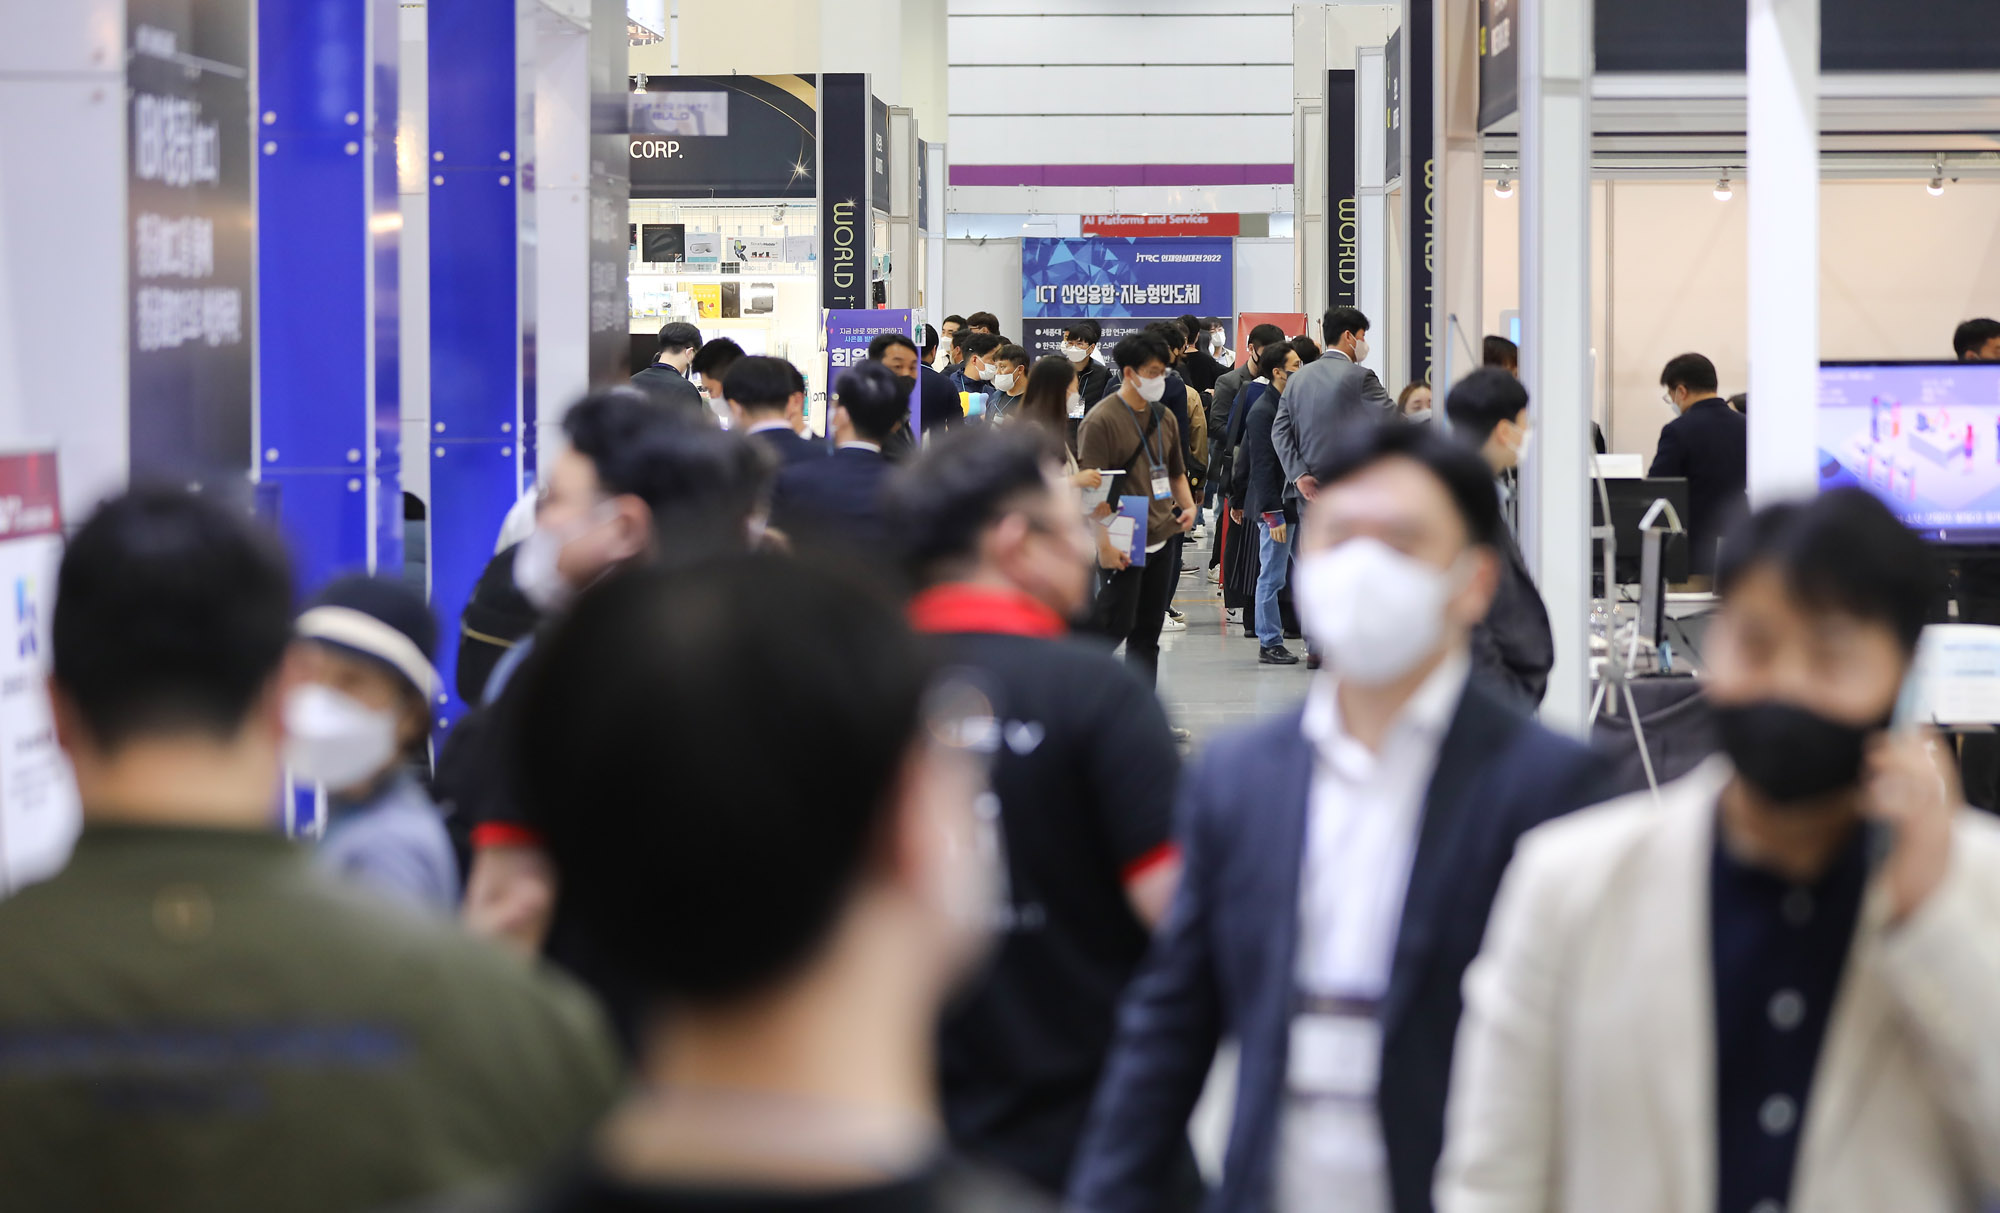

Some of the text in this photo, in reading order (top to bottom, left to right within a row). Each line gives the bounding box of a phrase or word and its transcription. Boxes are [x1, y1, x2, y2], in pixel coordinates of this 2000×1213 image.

[630, 141, 684, 159] CORP.
[1084, 215, 1209, 225] AI Platforms and Services
[833, 202, 854, 288] WORLD
[1338, 198, 1356, 284] WORLD
[1035, 285, 1058, 304] ICT
[839, 327, 852, 335] 지금
[852, 327, 865, 335] 바로
